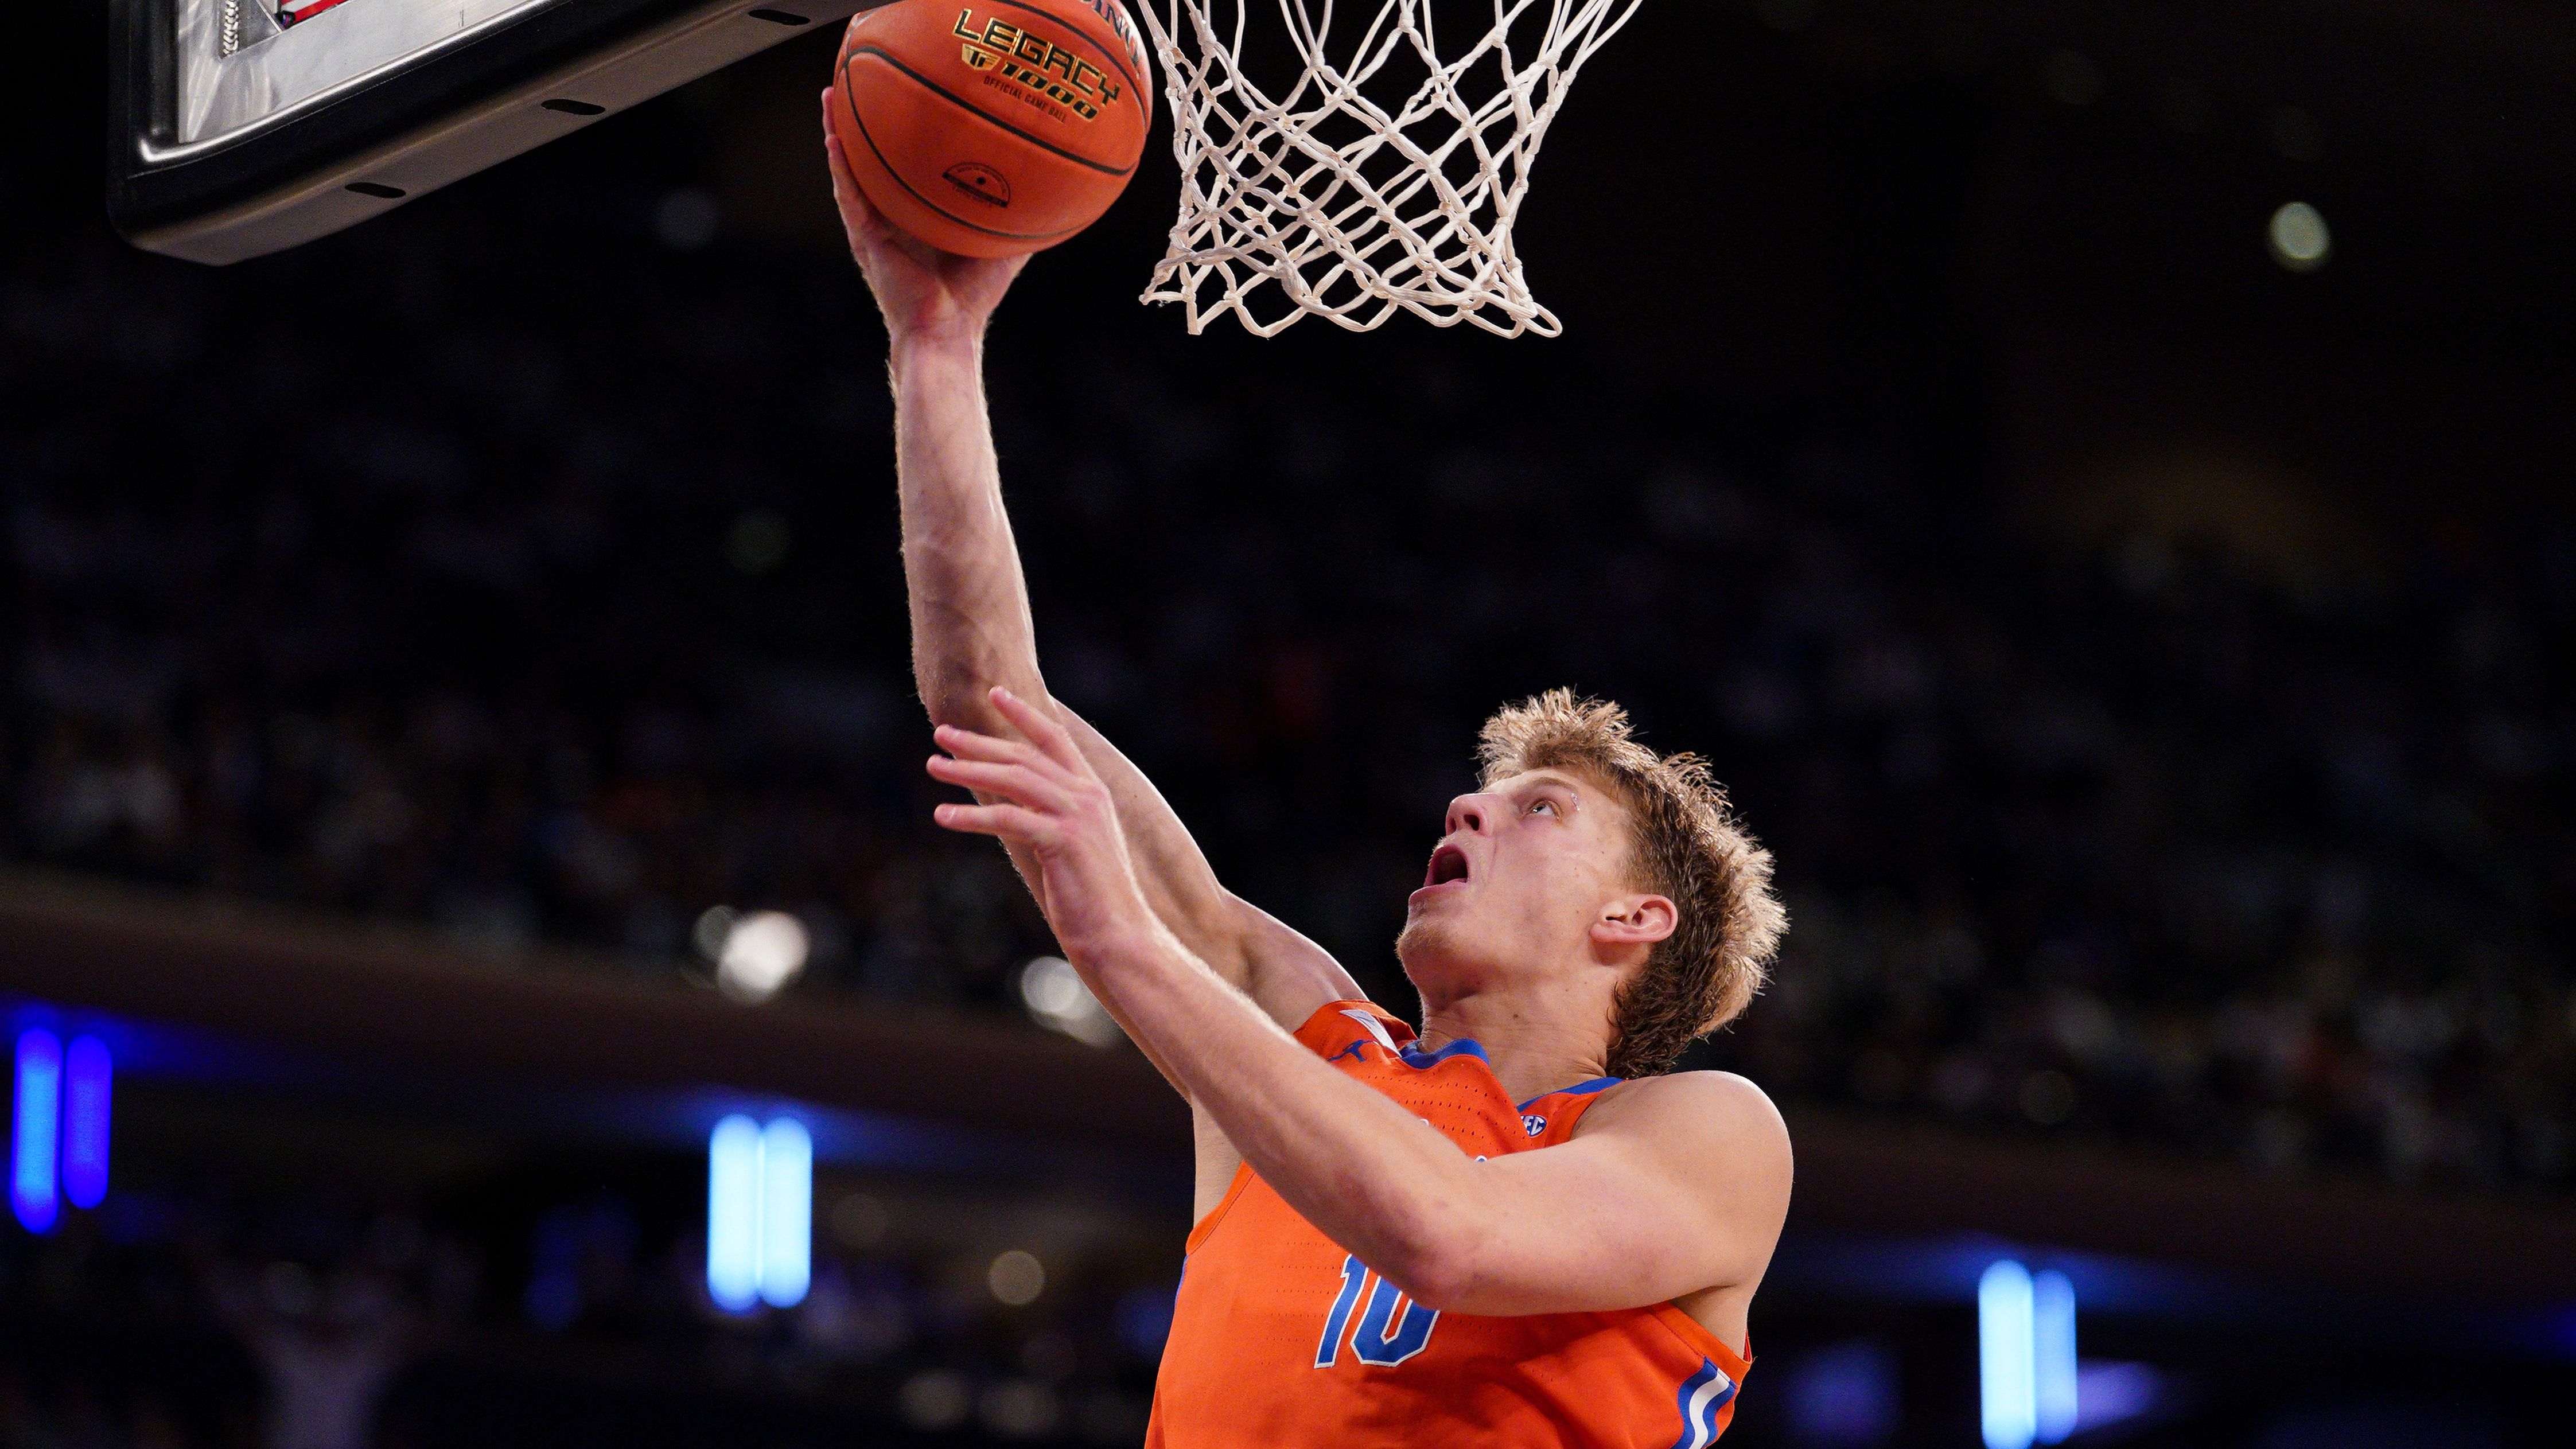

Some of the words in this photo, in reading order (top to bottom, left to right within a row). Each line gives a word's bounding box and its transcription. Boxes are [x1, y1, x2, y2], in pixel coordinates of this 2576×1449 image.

[952, 8, 1120, 106] LEGACY
[983, 75, 1022, 100] OFFICIAL
[1024, 93, 1048, 111] GAME
[1048, 106, 1067, 124] BALL
[1001, 60, 1099, 122] 1000
[1520, 1116, 1545, 1135] EC
[1313, 1253, 1441, 1369] 10
